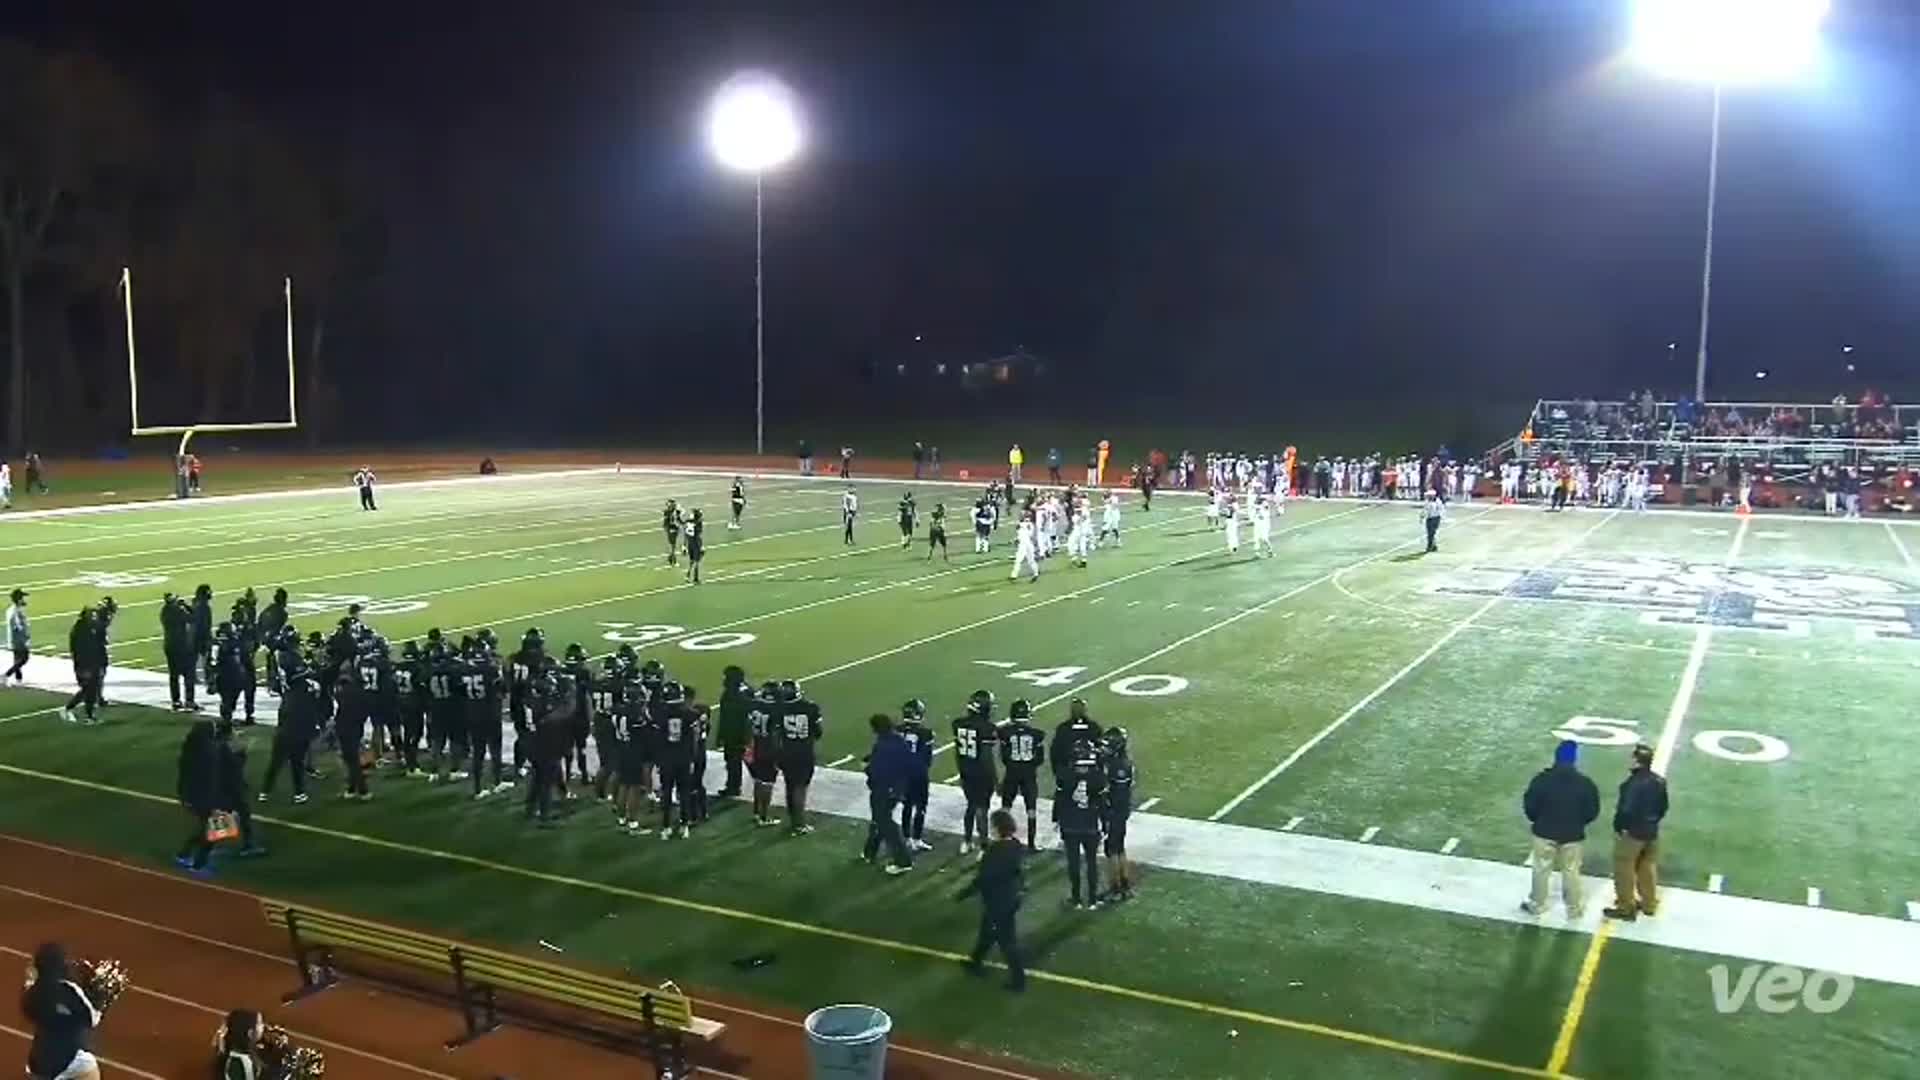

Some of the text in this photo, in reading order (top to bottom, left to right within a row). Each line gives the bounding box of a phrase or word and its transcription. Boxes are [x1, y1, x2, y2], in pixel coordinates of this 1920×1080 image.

[602, 623, 758, 650] 30
[1005, 666, 1189, 696] 40
[957, 727, 977, 758] 55
[1551, 715, 1790, 762] 50
